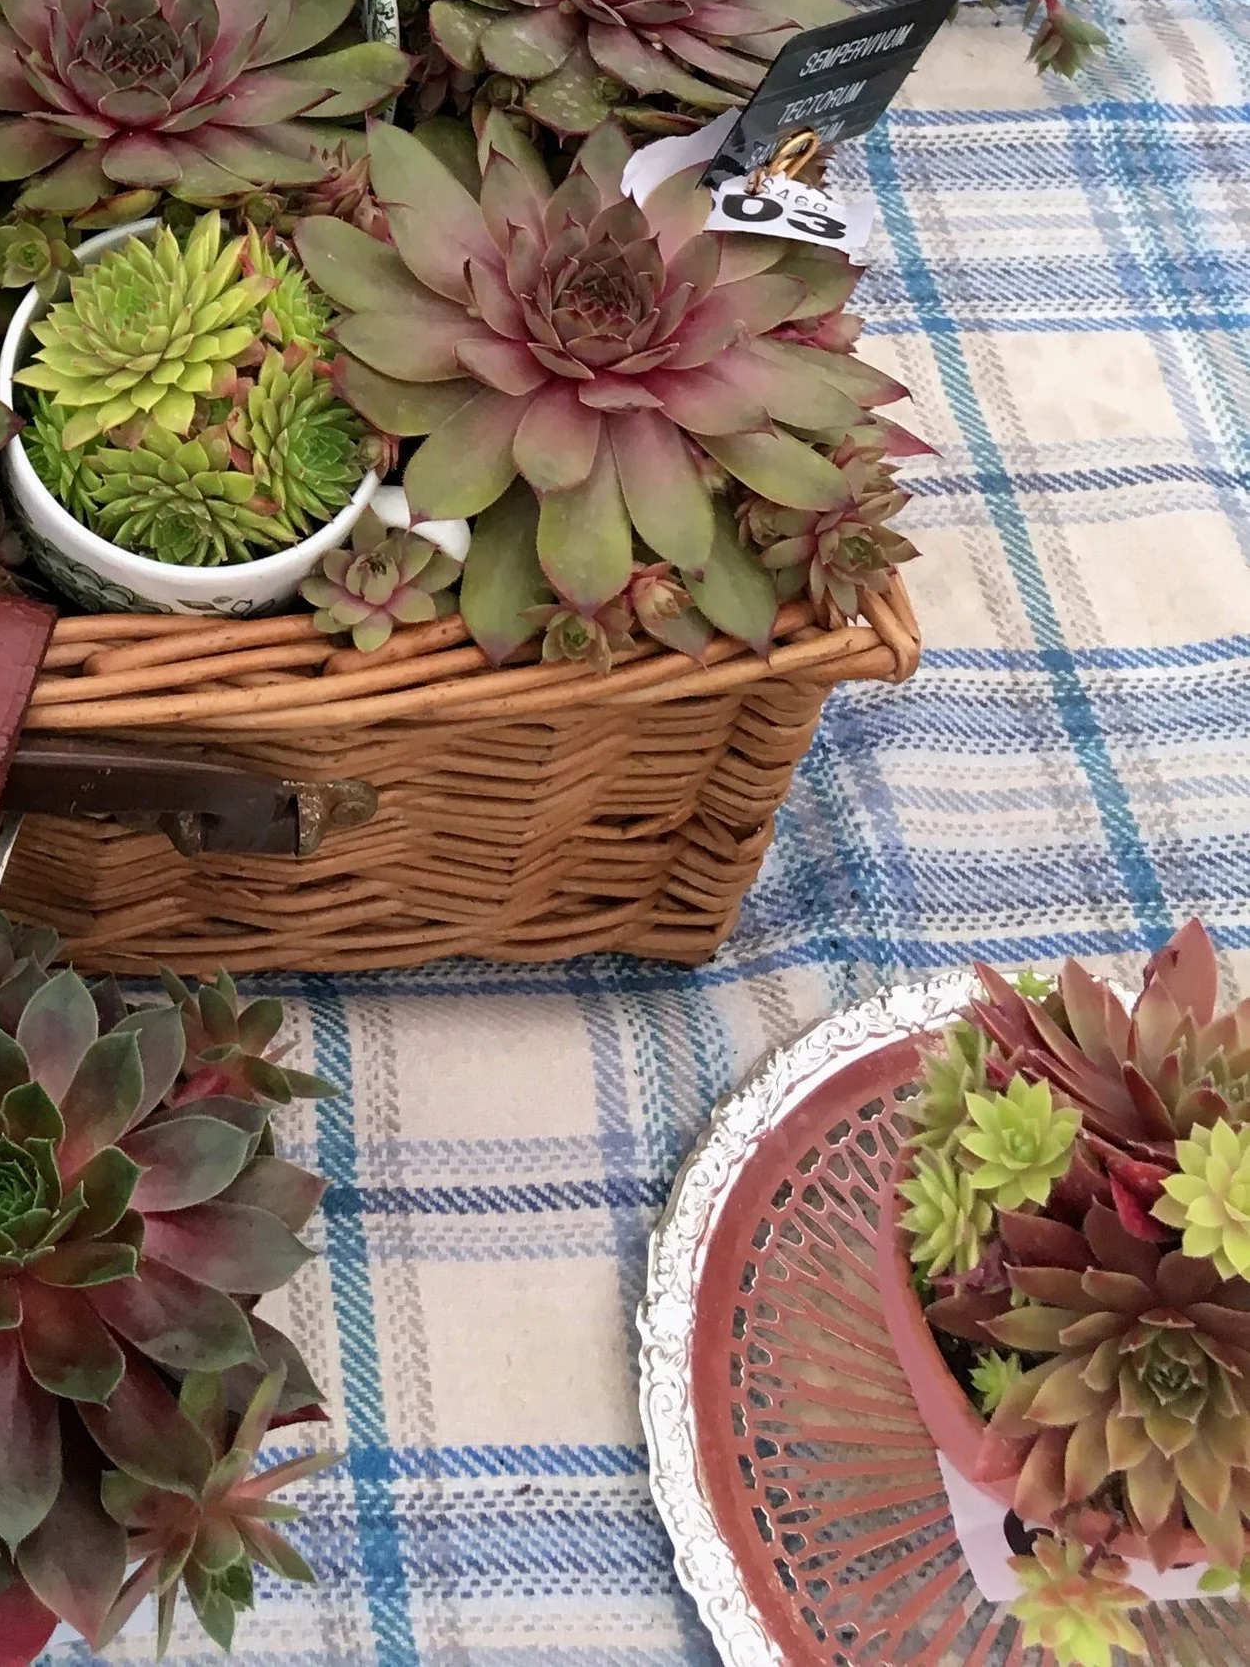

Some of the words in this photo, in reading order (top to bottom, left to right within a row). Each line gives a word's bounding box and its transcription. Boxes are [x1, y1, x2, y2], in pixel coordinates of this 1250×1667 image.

[799, 22, 915, 77] SEMPERVIVUM
[778, 80, 867, 126] TECTORUM
[712, 194, 847, 239] 03
